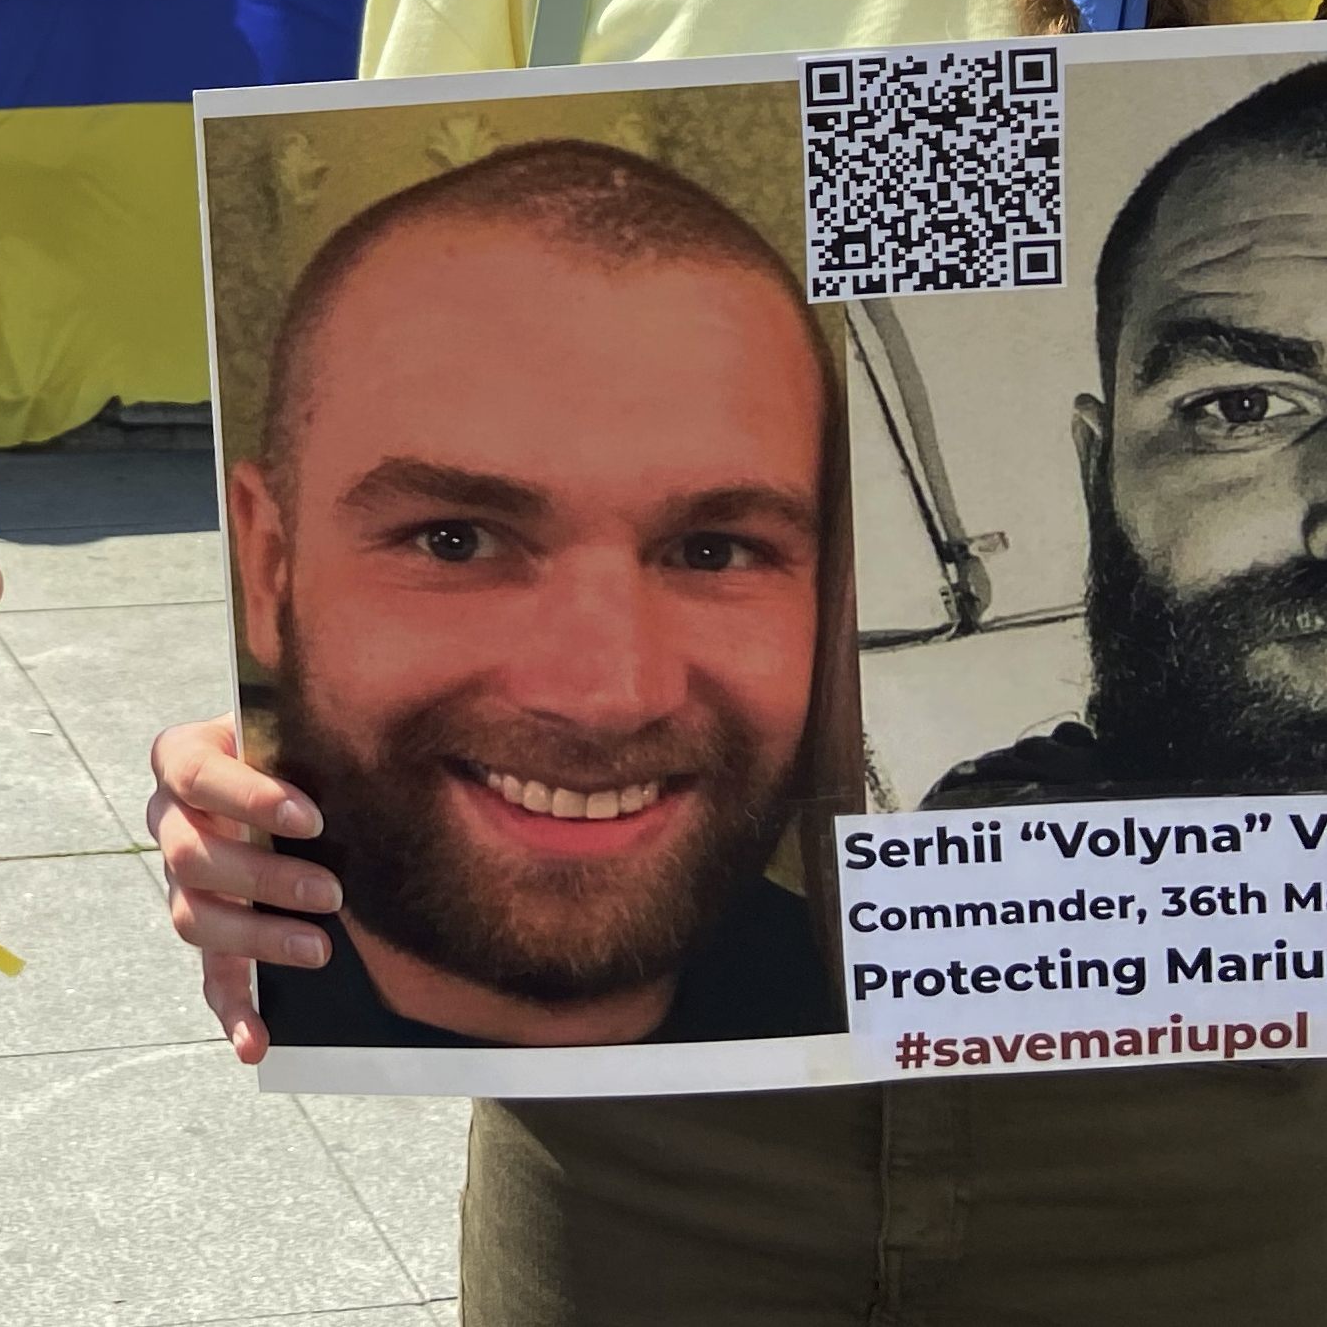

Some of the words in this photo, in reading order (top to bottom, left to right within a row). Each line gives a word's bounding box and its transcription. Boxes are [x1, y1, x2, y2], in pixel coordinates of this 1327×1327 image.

[844, 820, 1003, 870] Serhii
[1019, 811, 1273, 866] “Volyna”
[848, 888, 1148, 933] Commander,
[1161, 882, 1268, 917] 36th
[1284, 881, 1327, 913] M
[853, 947, 1147, 1001] Protecting
[1166, 938, 1325, 985] Mariu
[894, 1010, 1309, 1070] #savemariupol
